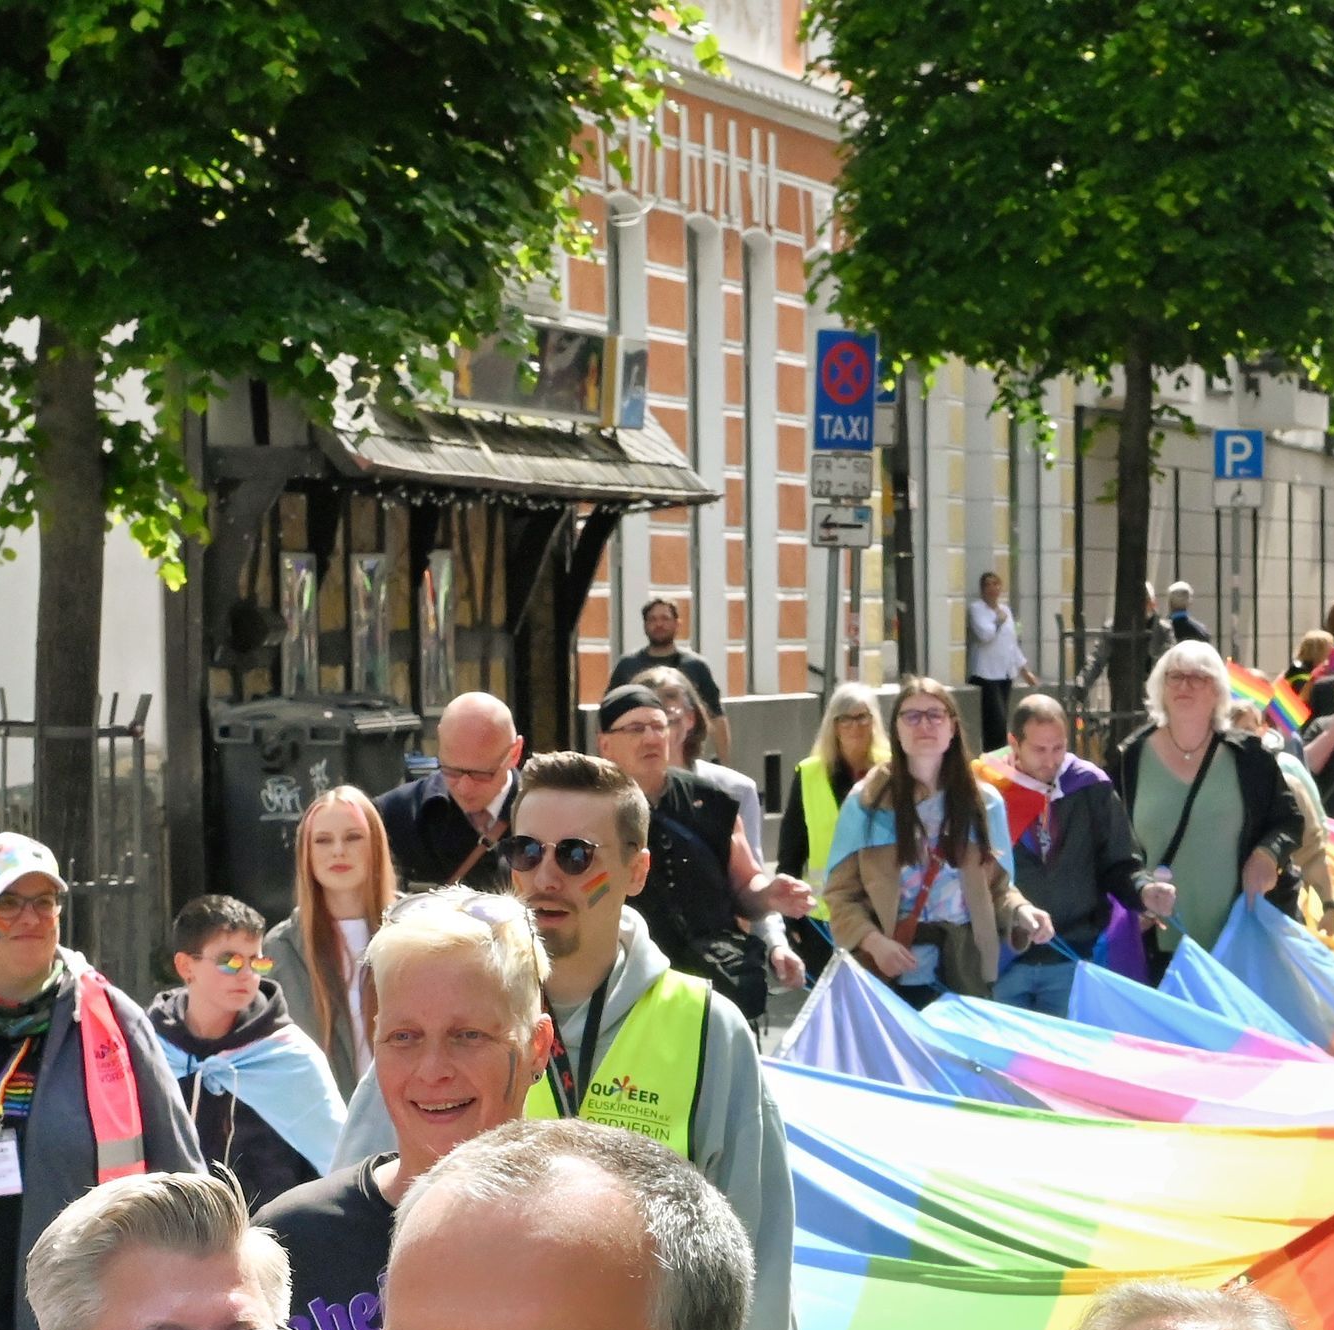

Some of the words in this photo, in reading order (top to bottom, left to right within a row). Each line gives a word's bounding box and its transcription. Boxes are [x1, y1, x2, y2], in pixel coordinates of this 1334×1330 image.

[819, 414, 869, 441] TAXI
[1224, 435, 1253, 477] P
[590, 1082, 660, 1106] QUEER
[587, 1098, 658, 1119] EUSKIRCHEN
